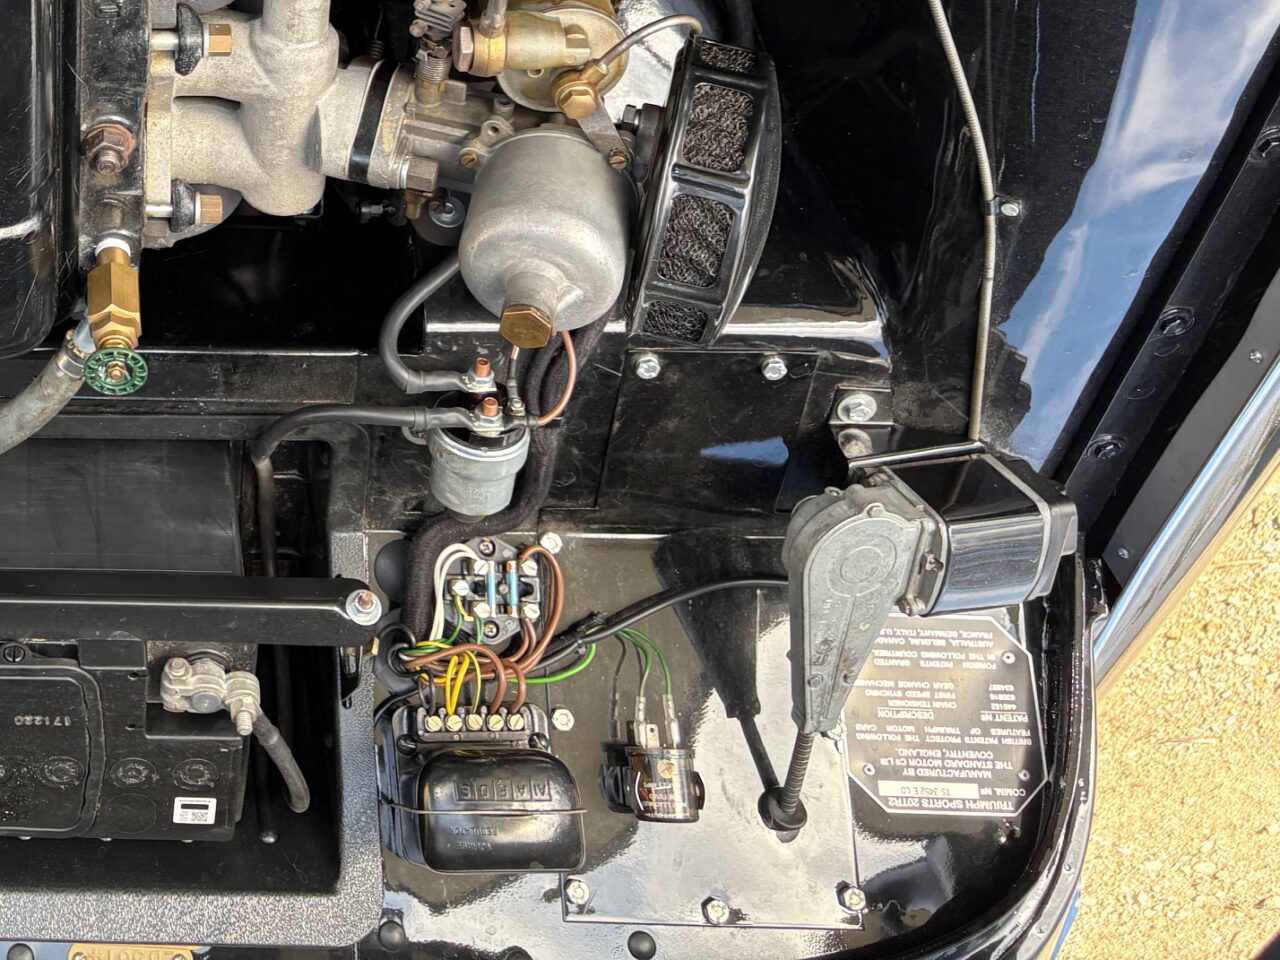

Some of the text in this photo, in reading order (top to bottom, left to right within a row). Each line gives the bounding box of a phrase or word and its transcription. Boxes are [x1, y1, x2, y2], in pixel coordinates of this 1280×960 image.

[894, 628, 916, 636] ITALY,
[917, 628, 957, 637] GERMANY,
[908, 638, 946, 646] BELGIUM,
[950, 639, 993, 647] AUSTRALIA,
[920, 651, 965, 659] FOLLOWING
[864, 689, 902, 697] SYNCHRO
[878, 709, 934, 719] DESCRIPTION
[994, 714, 1028, 722] PATENT
[925, 726, 960, 734] TRIUMPH
[856, 732, 901, 741] FOLLOWING
[904, 734, 920, 742] THE
[926, 735, 961, 743] PROTECT
[896, 748, 993, 758] COVENTRY, ENGLAND.
[908, 759, 942, 767] MOTOR
[944, 760, 992, 768] STANDARD
[995, 761, 1013, 769] THE
[903, 768, 992, 778] MANUFACTURED BY
[994, 788, 1026, 796] COMM.
[888, 797, 1014, 810] TRIUMPH SPORTS 20TR2
